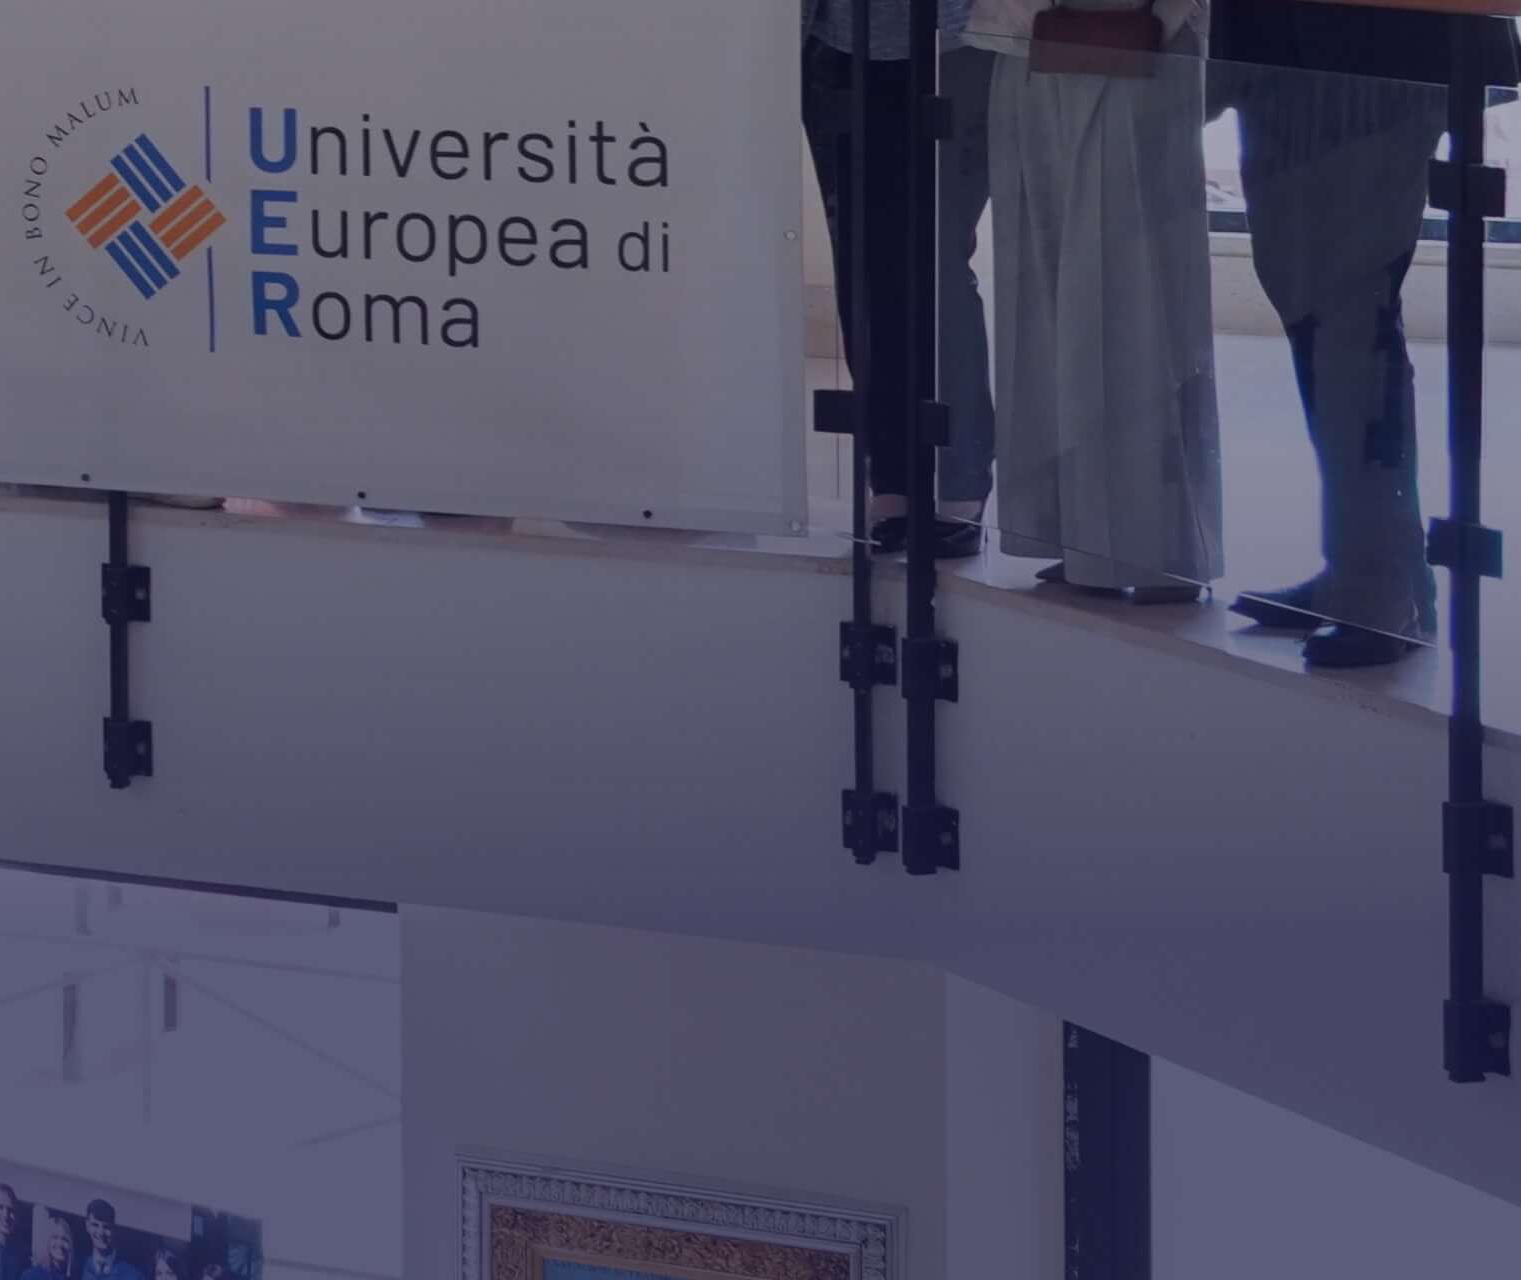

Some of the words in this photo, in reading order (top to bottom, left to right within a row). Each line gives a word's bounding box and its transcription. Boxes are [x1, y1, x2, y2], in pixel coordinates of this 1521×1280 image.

[46, 87, 139, 147] MALUM
[248, 107, 670, 188] Università
[22, 156, 48, 240] BONO
[250, 189, 590, 277] Europea
[616, 220, 671, 273] di
[33, 256, 62, 288] IN
[251, 270, 481, 349] Roma
[62, 293, 150, 347] VINCE
